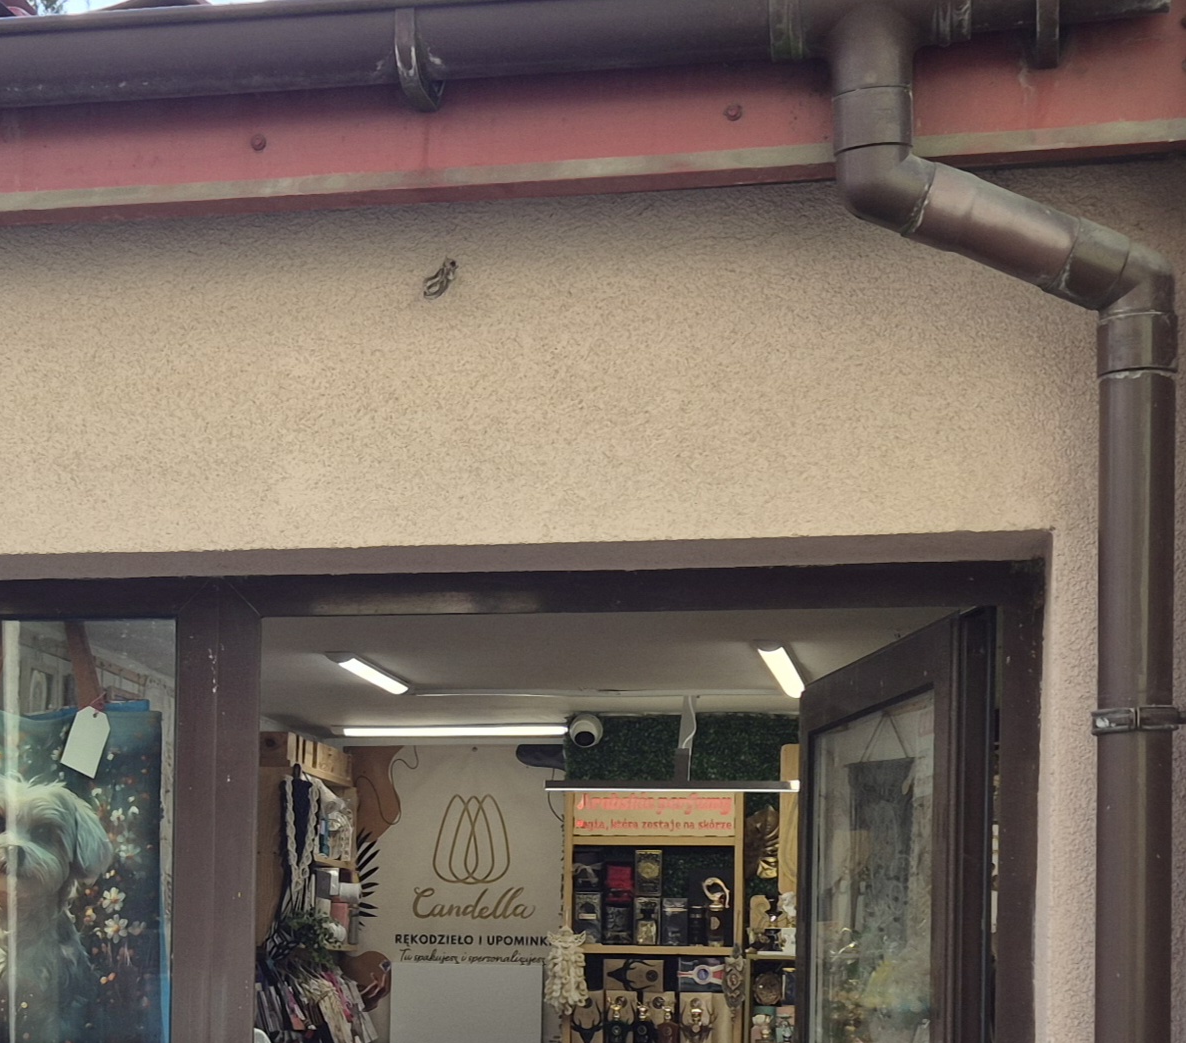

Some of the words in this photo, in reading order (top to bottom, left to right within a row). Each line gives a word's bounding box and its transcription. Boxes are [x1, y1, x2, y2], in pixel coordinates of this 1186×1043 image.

[642, 819, 683, 832] zostaje
[684, 821, 695, 830] na
[698, 819, 732, 830] skórze
[412, 886, 536, 920] Candella
[395, 934, 474, 947] RĘKODZIEŁO
[479, 935, 483, 946] I
